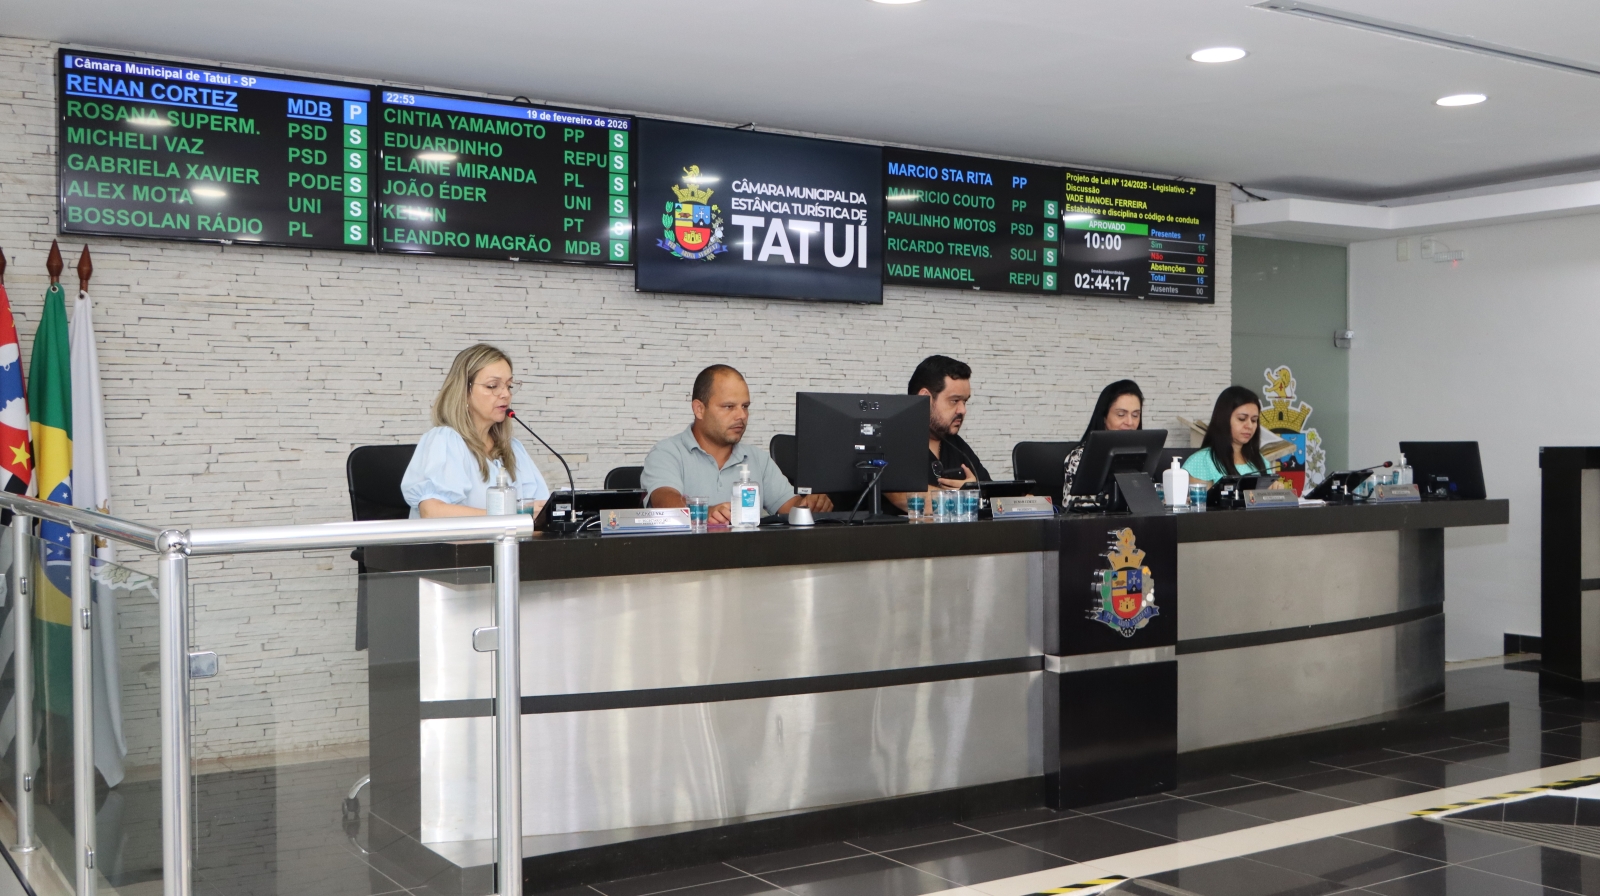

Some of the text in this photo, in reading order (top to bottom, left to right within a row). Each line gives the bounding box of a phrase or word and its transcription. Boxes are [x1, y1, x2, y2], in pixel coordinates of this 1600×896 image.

[74, 57, 122, 73] Câmara
[125, 63, 183, 80] Municipal
[185, 70, 200, 81] de
[203, 71, 231, 85] Tatuí
[240, 76, 257, 88] SP
[66, 73, 362, 120] RENAN CORTEZ MDB P
[386, 92, 415, 105] 22:53
[67, 100, 362, 144] ROSANA SUPERM. PSD S
[384, 108, 624, 147] CINTIA YAMAMOTO PP S
[526, 110, 628, 130] 19 de fevereiro de 2026
[67, 127, 362, 168] MICHELI VAZ PSD S
[384, 131, 624, 169] EDUARDINHO REPU S
[67, 154, 362, 193] GABRIELA XAVIER PODE S
[384, 155, 624, 191] ELAINE MIRANDA PL S
[888, 162, 1028, 189] MARCIO STA RITA PP
[1066, 172, 1090, 184] Projeto
[1090, 175, 1099, 184] de
[1100, 176, 1111, 185] Lei
[1121, 179, 1148, 190] 124/2025
[1152, 183, 1185, 194] Legislativo
[67, 180, 362, 217] ALEX MOTA UNI S
[382, 178, 624, 213] JOÃO ÉDER UNI S
[732, 178, 867, 206] CÂMARA MUNICIPAL DA
[888, 186, 1055, 216] MAURICIO COUTO PP S
[1066, 183, 1100, 194] Discussão
[732, 197, 867, 221] ESTÂNCIA TURÍSTICA DE
[1066, 193, 1148, 210] VADE MANOEL FERREIRA
[68, 206, 362, 241] BOSSOLAN RÁDIO PL S
[564, 218, 584, 233] PT
[888, 211, 1055, 238] PAULINHO MOTOS PSD S
[1066, 204, 1101, 215] Estabelece
[1108, 208, 1138, 219] disciplina
[1144, 211, 1165, 222] código
[1166, 213, 1174, 222] de
[1175, 215, 1200, 225] conduta
[1089, 220, 1126, 231] APROVADO
[384, 228, 624, 258] LEANDRO MAGRÃO MDB S
[732, 214, 868, 269] TATUÍ
[1084, 231, 1122, 251] 10:00
[1151, 229, 1181, 239] Presentes
[1151, 241, 1163, 249] Sim
[887, 237, 1054, 263] RICARDO TREVIS. SOLI S
[1151, 252, 1163, 260] Não
[887, 263, 1054, 287] VADE MANOEL REPU S
[1151, 263, 1204, 274] Abstenções 00
[1151, 274, 1166, 282] Total
[1074, 272, 1130, 291] 02:44:17
[1151, 285, 1178, 293] Ausentes
